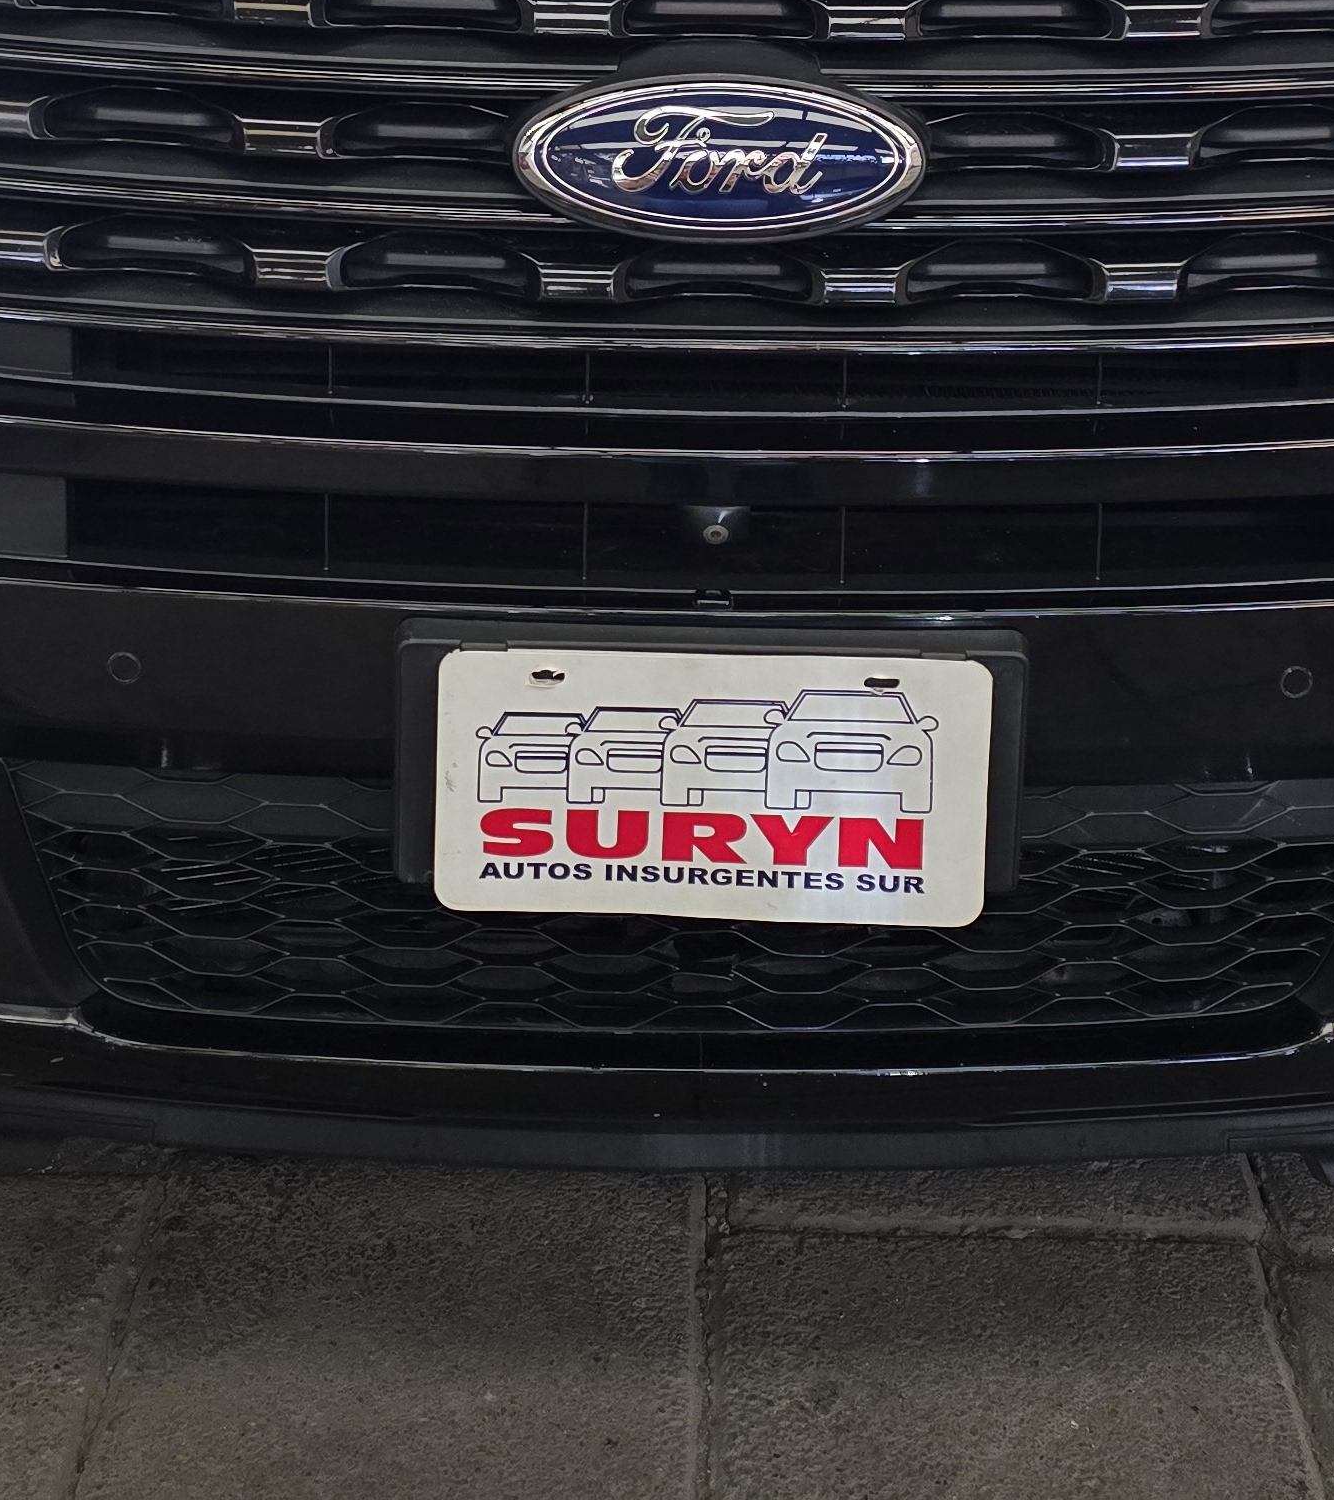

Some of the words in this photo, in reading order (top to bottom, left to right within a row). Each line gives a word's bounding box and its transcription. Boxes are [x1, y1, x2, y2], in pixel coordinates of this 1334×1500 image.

[611, 105, 828, 195] Ford
[480, 808, 925, 869] SURYN
[479, 862, 592, 881] AUTOS
[604, 864, 845, 891] INSURGENTES
[856, 875, 925, 894] SUR
